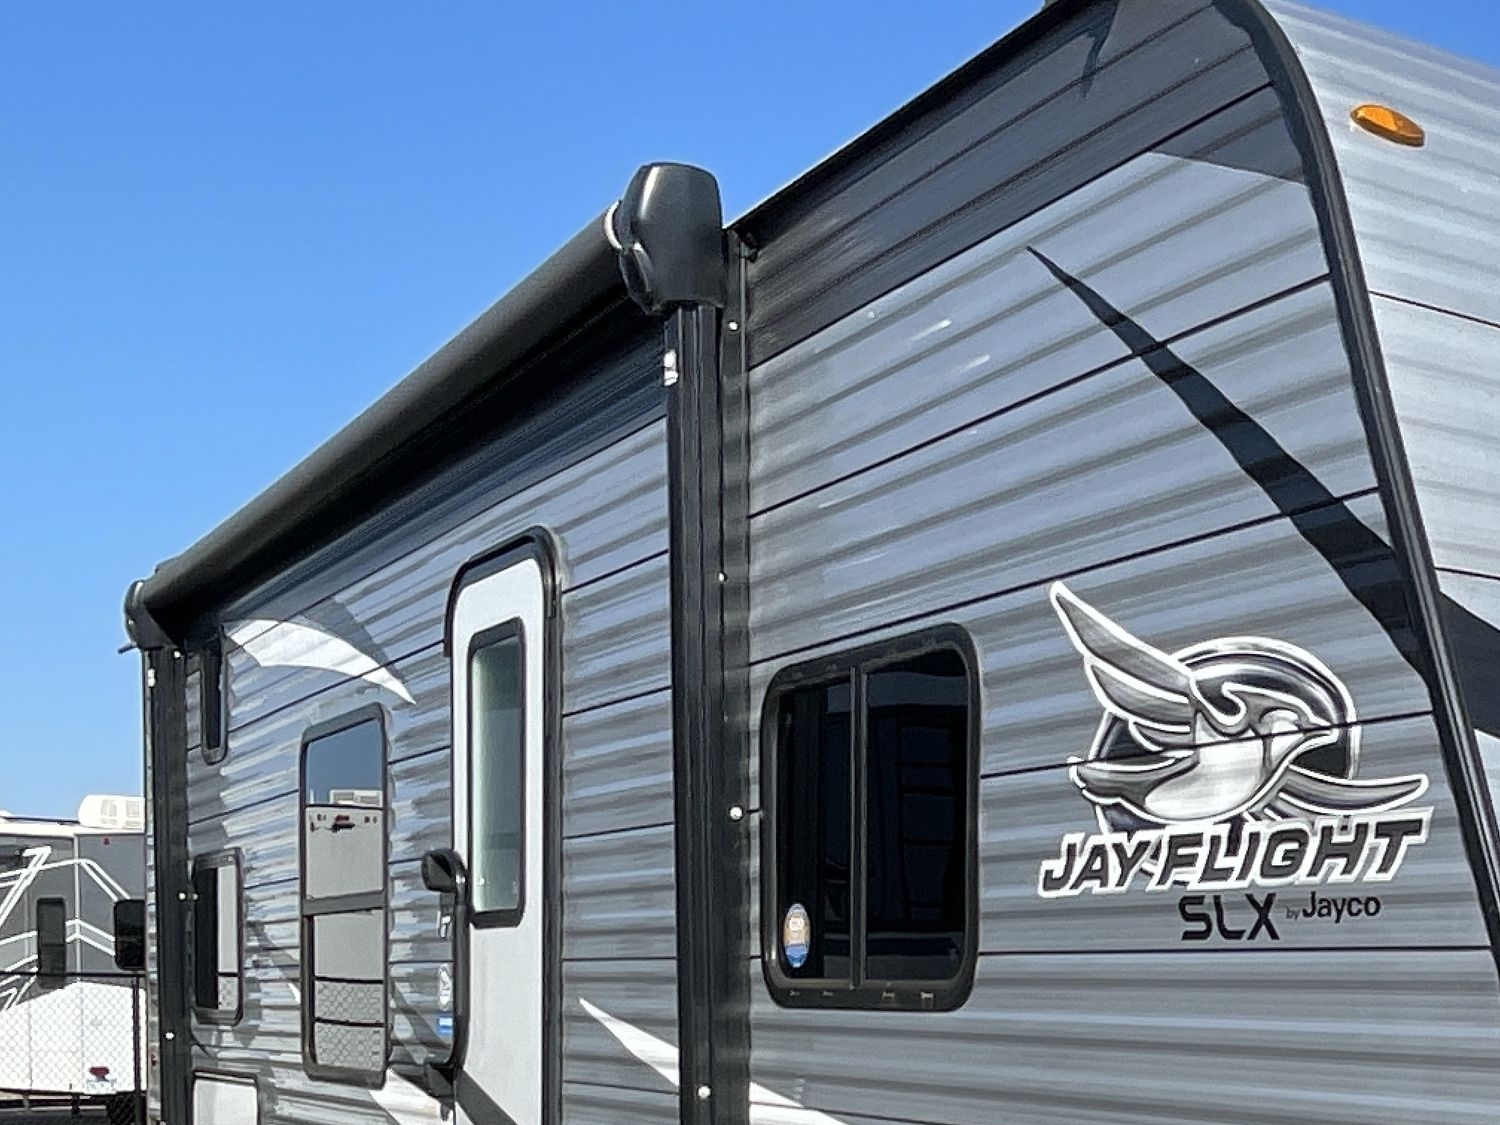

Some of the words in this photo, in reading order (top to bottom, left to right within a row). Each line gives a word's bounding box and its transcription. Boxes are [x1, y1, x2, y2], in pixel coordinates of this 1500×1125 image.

[1040, 833, 1151, 896] JAY
[1148, 807, 1433, 892] FLIGHT
[1178, 892, 1280, 941] SLX
[1302, 891, 1381, 924] Jayco
